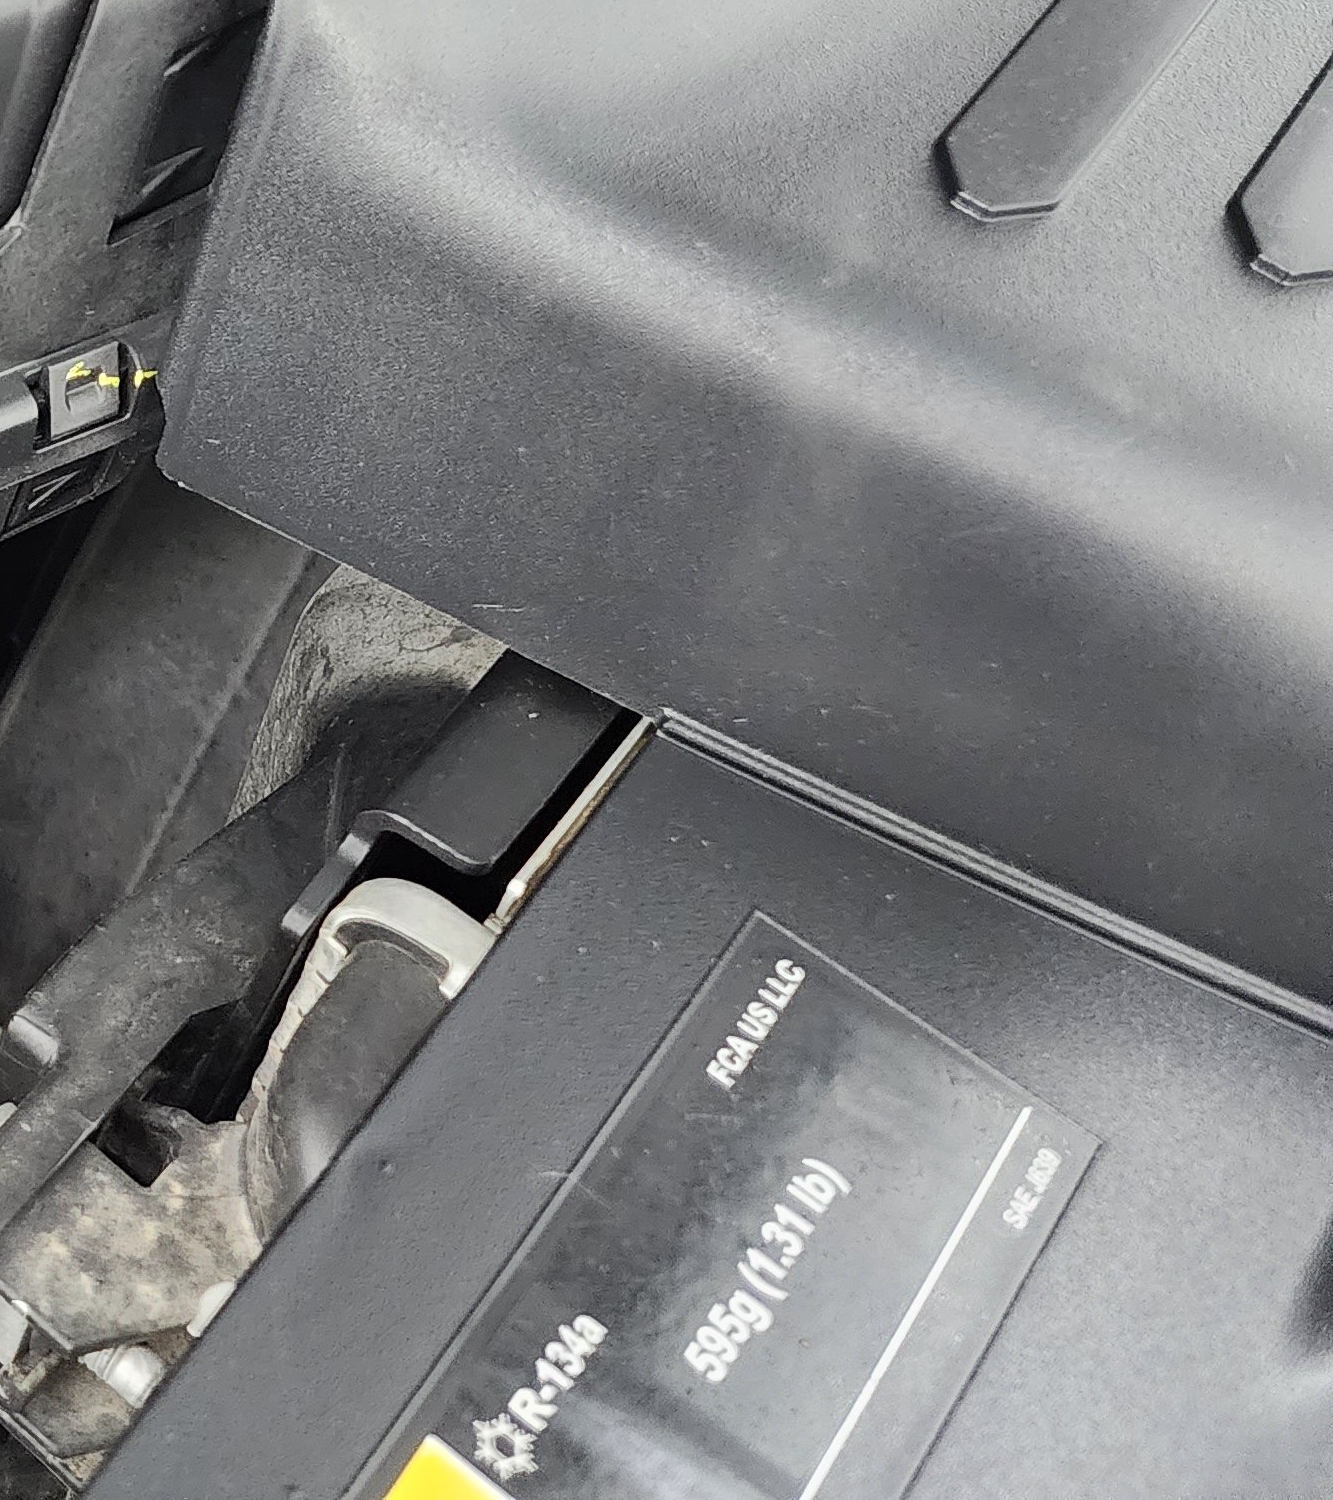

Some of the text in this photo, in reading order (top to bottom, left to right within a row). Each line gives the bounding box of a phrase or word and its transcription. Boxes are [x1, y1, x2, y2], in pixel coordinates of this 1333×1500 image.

[705, 958, 806, 1089] FCA US LLC
[683, 1157, 854, 1382] 595g (1.31 lb)
[1002, 1185, 1044, 1230] SAE
[507, 1313, 610, 1435] R-134a
